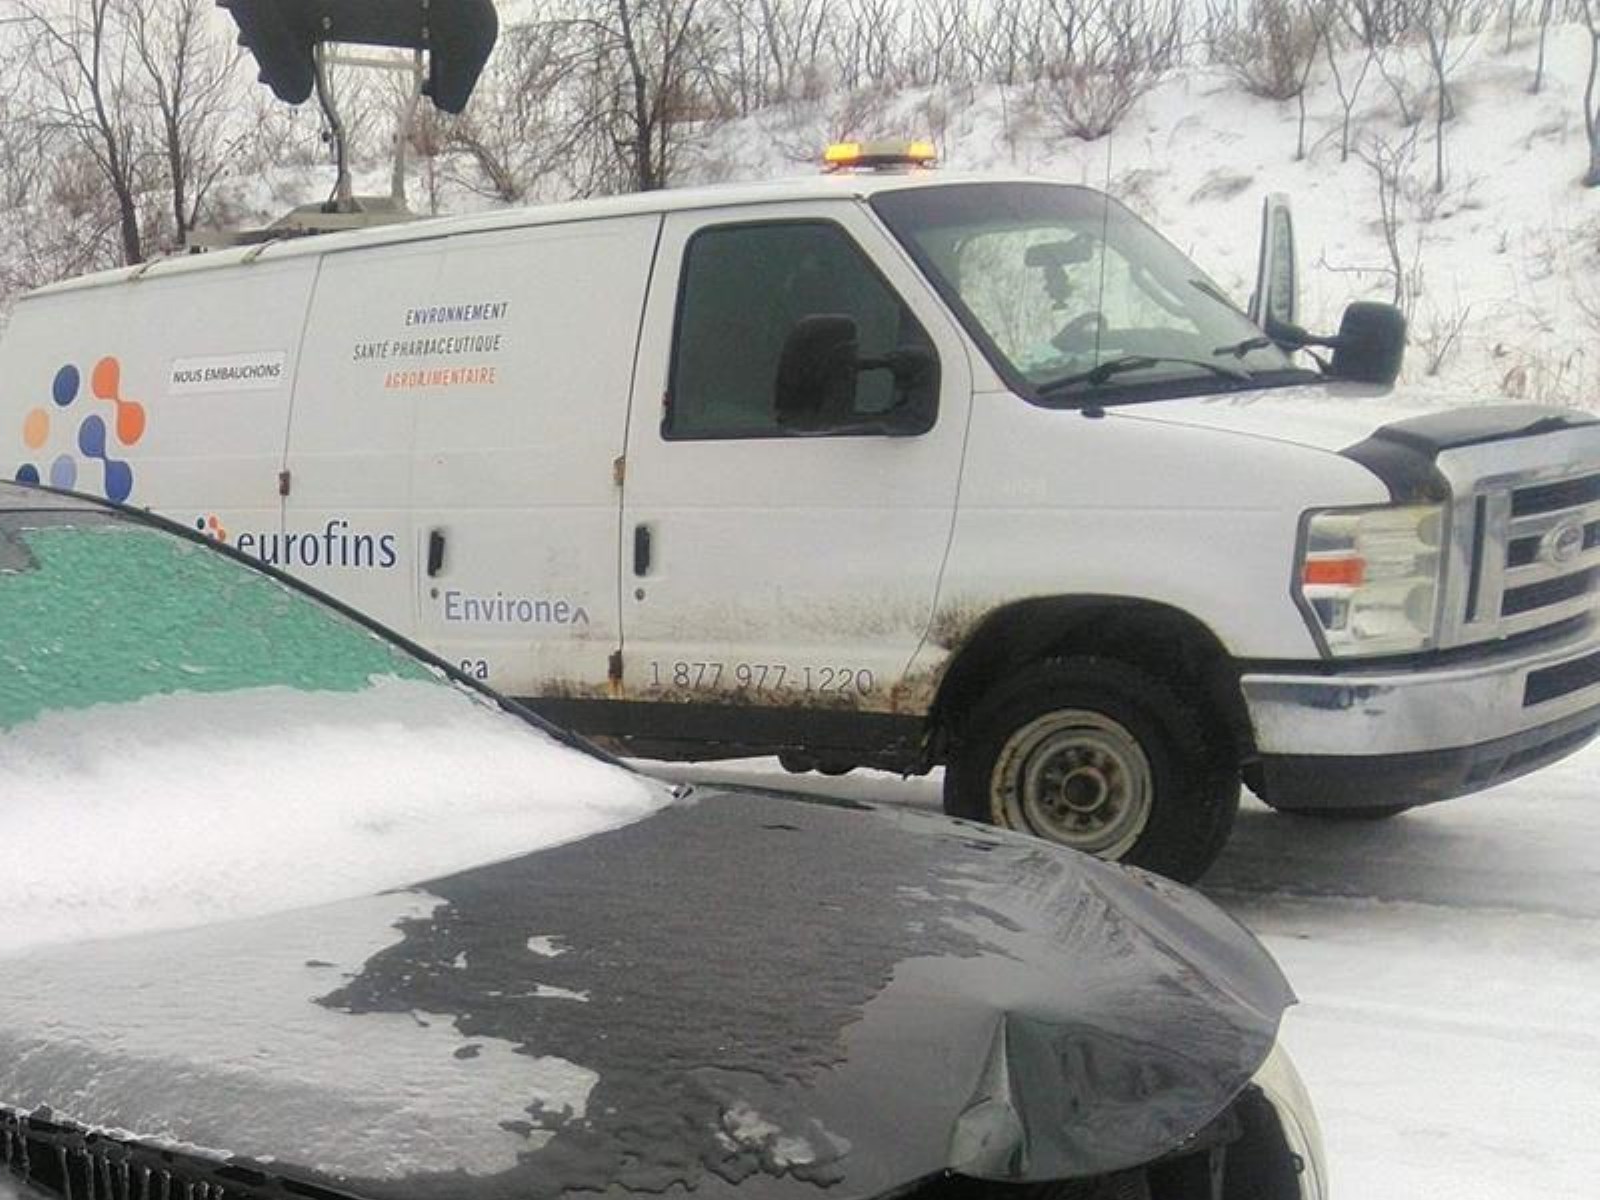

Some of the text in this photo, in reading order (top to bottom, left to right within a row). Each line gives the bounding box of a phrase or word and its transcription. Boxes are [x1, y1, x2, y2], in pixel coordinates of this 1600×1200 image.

[353, 341, 389, 360] SANTÉ
[173, 363, 281, 382] NOUS EMBAUCHONS
[237, 521, 396, 567] eurofins
[651, 661, 660, 687] 1
[673, 662, 723, 694] 877
